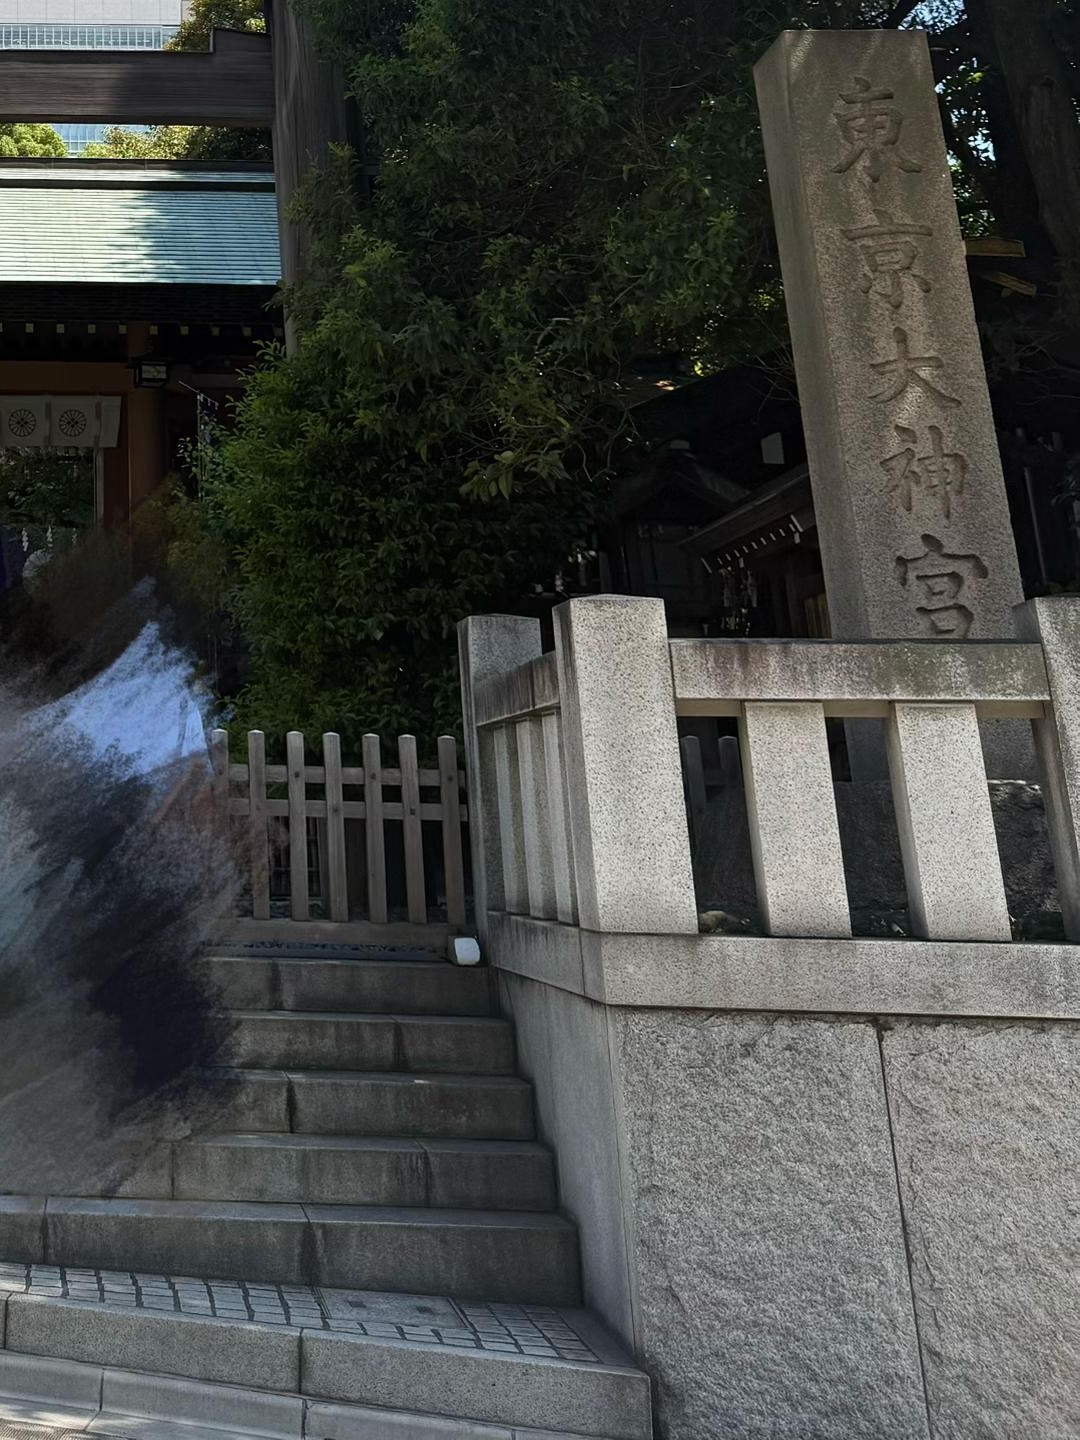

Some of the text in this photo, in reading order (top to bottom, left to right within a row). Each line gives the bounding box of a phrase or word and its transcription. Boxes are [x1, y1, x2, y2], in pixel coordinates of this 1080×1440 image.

[831, 75, 989, 640] 東京大神宮
